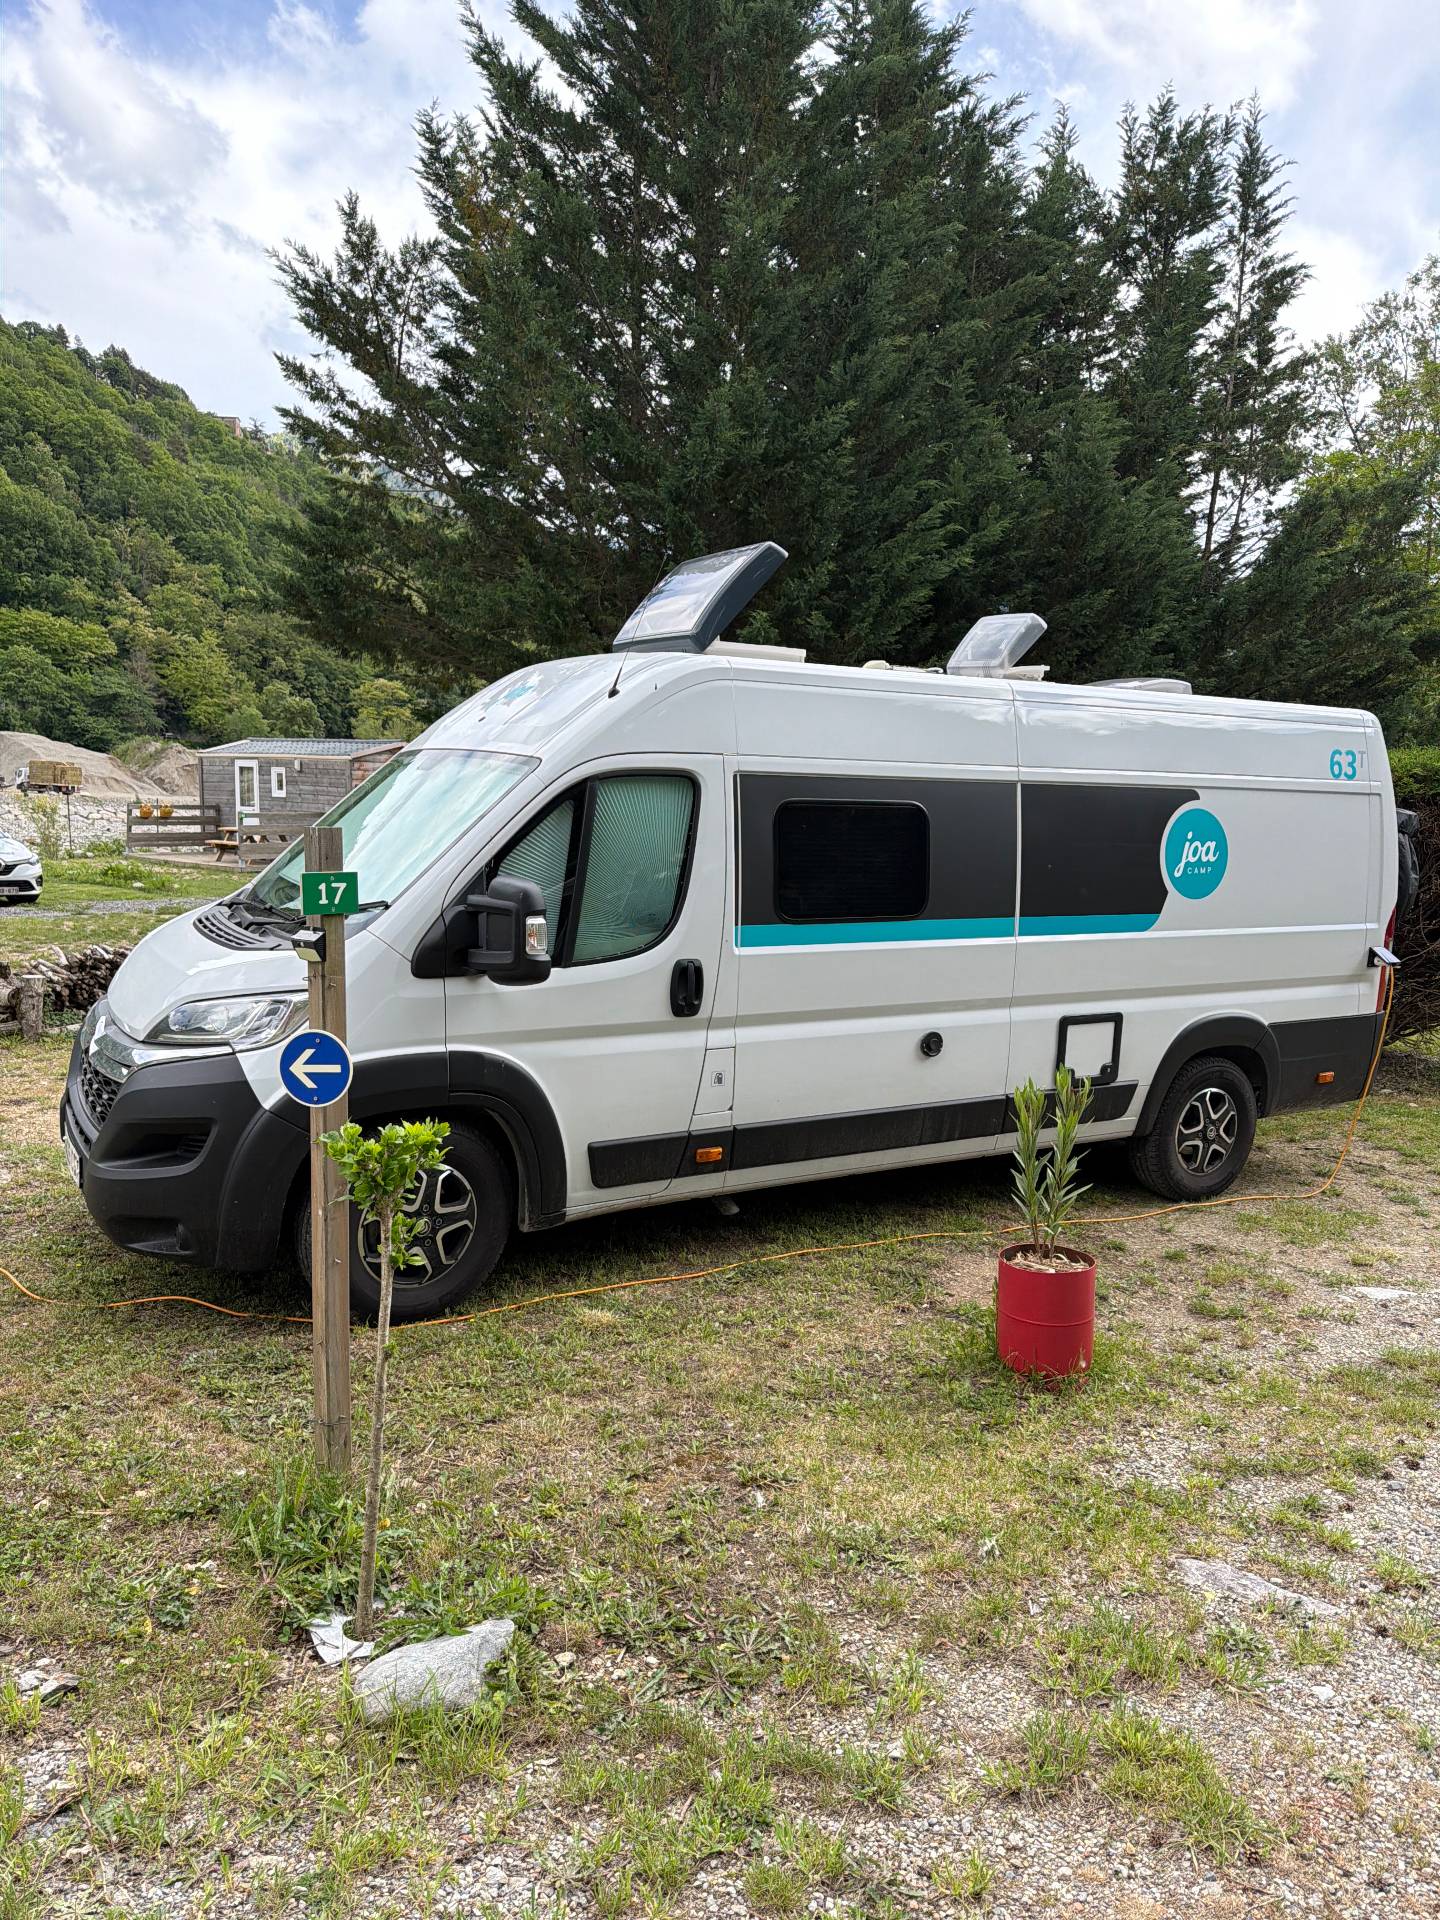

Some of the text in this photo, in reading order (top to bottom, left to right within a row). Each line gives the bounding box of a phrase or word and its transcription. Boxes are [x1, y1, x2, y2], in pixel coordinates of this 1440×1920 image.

[1174, 831, 1219, 878] joa
[1187, 866, 1212, 874] CAMP
[318, 882, 347, 905] 17
